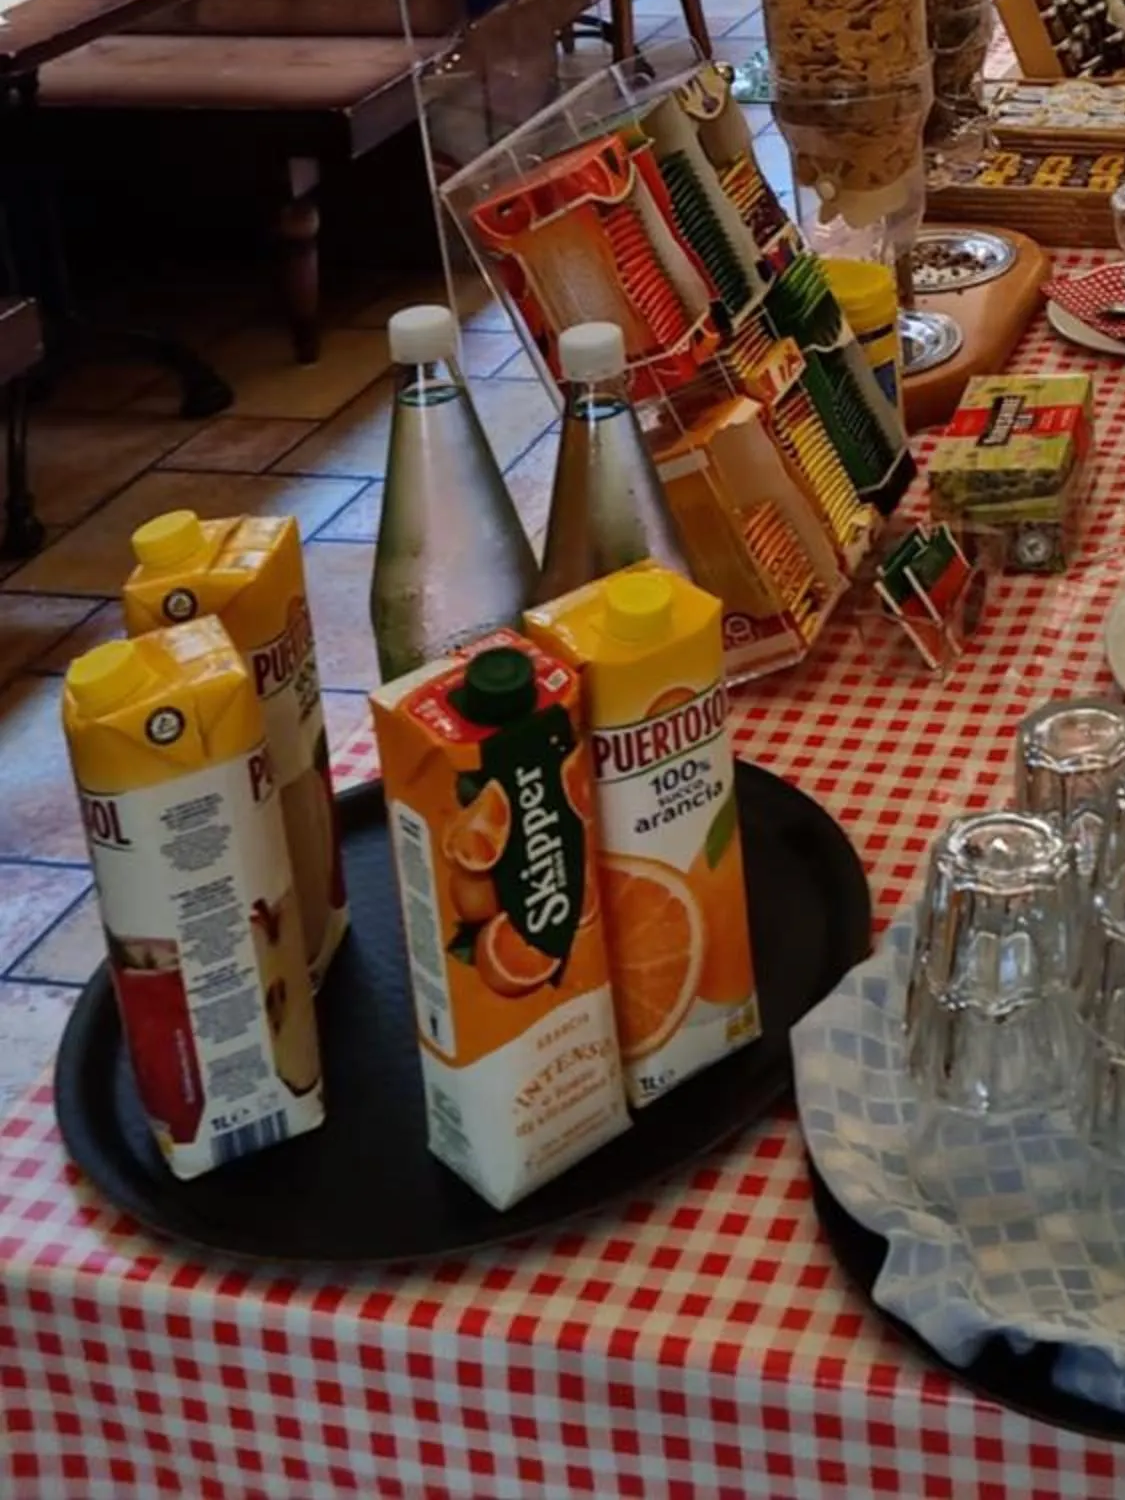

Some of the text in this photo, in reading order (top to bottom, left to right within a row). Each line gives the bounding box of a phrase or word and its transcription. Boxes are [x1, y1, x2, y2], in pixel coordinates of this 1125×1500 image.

[591, 687, 732, 779] PUERTOSO
[514, 766, 571, 934] Skipper
[633, 780, 724, 834] arancia
